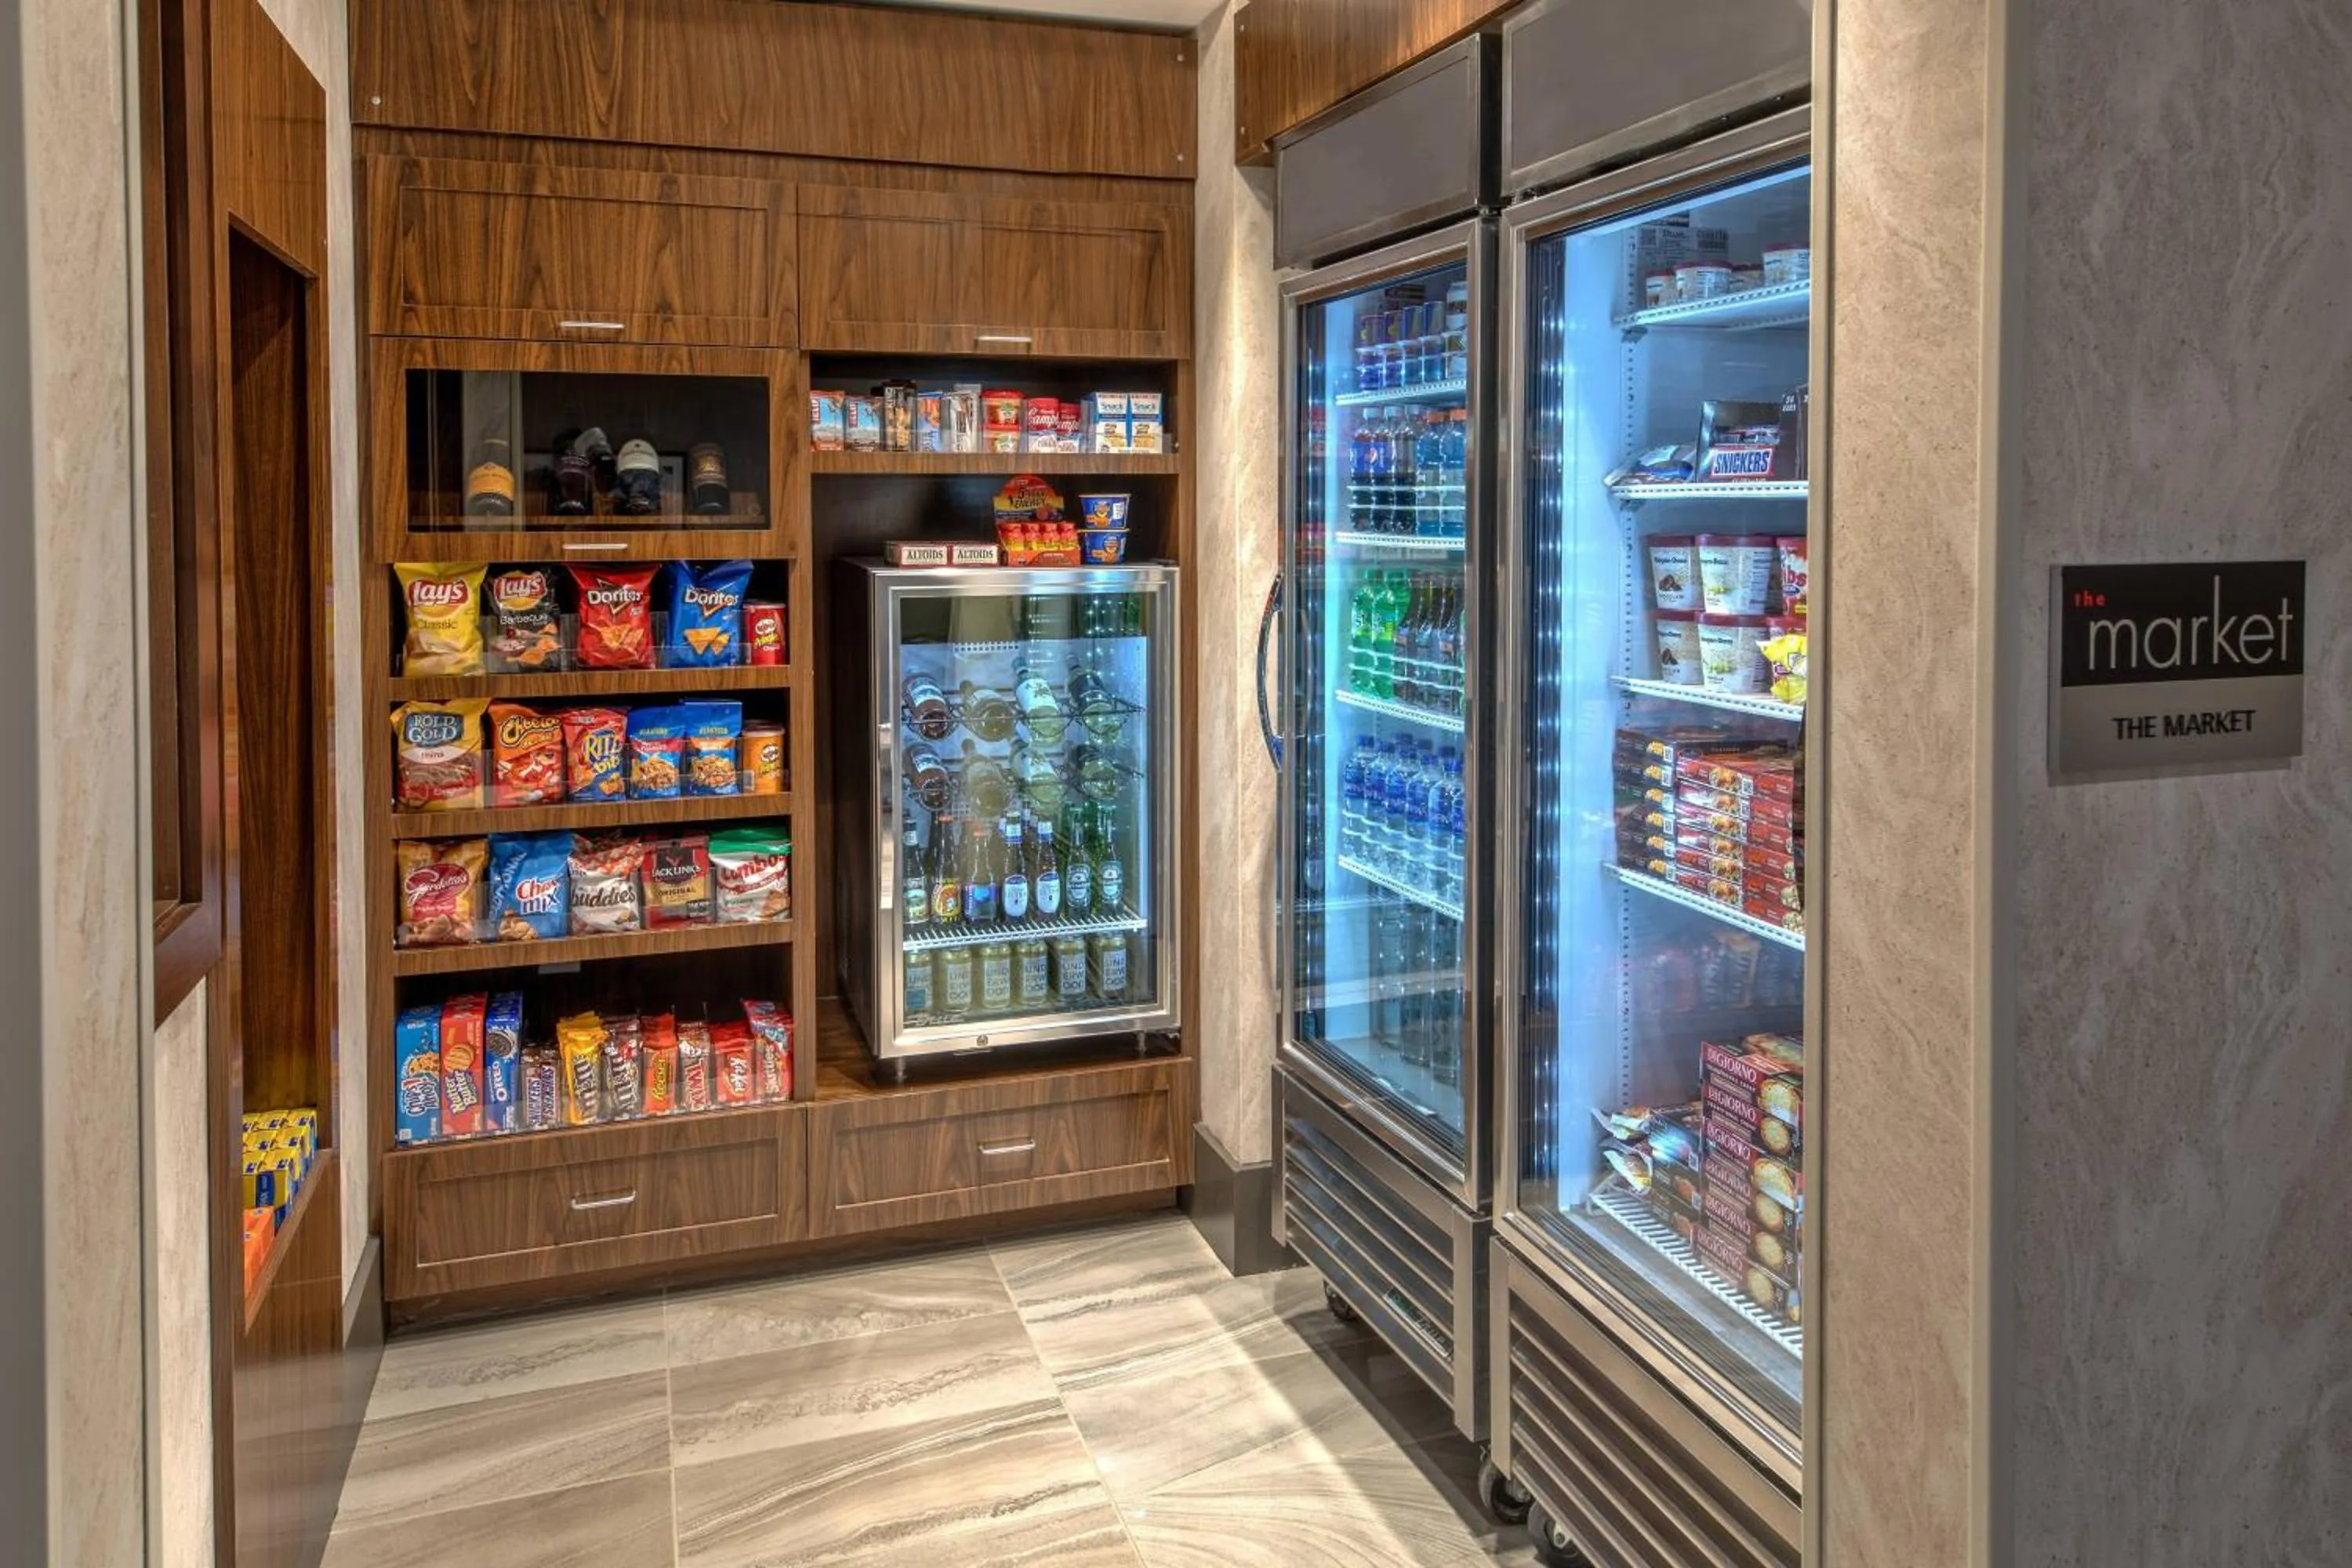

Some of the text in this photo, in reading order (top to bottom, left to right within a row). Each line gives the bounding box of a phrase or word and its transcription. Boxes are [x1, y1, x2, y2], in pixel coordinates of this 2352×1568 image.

[1714, 452, 1770, 474] SNICKERS
[906, 549, 944, 561] ALTOIDS
[956, 549, 994, 561] ALTOIDS
[412, 579, 465, 605] Lay's
[496, 575, 543, 599] Lay's
[588, 590, 641, 605] Doritos
[684, 587, 739, 606] Doritos
[2074, 590, 2107, 607] the
[418, 619, 458, 630] Classic
[2089, 575, 2293, 670] market
[413, 714, 456, 727] ROLD
[2112, 710, 2256, 740] THE MARKET
[408, 726, 457, 743] GOLD
[571, 885, 637, 908] buddies
[764, 1045, 779, 1094] Skittles
[444, 1070, 477, 1114] Nutter Butter
[492, 1061, 507, 1101] OREO
